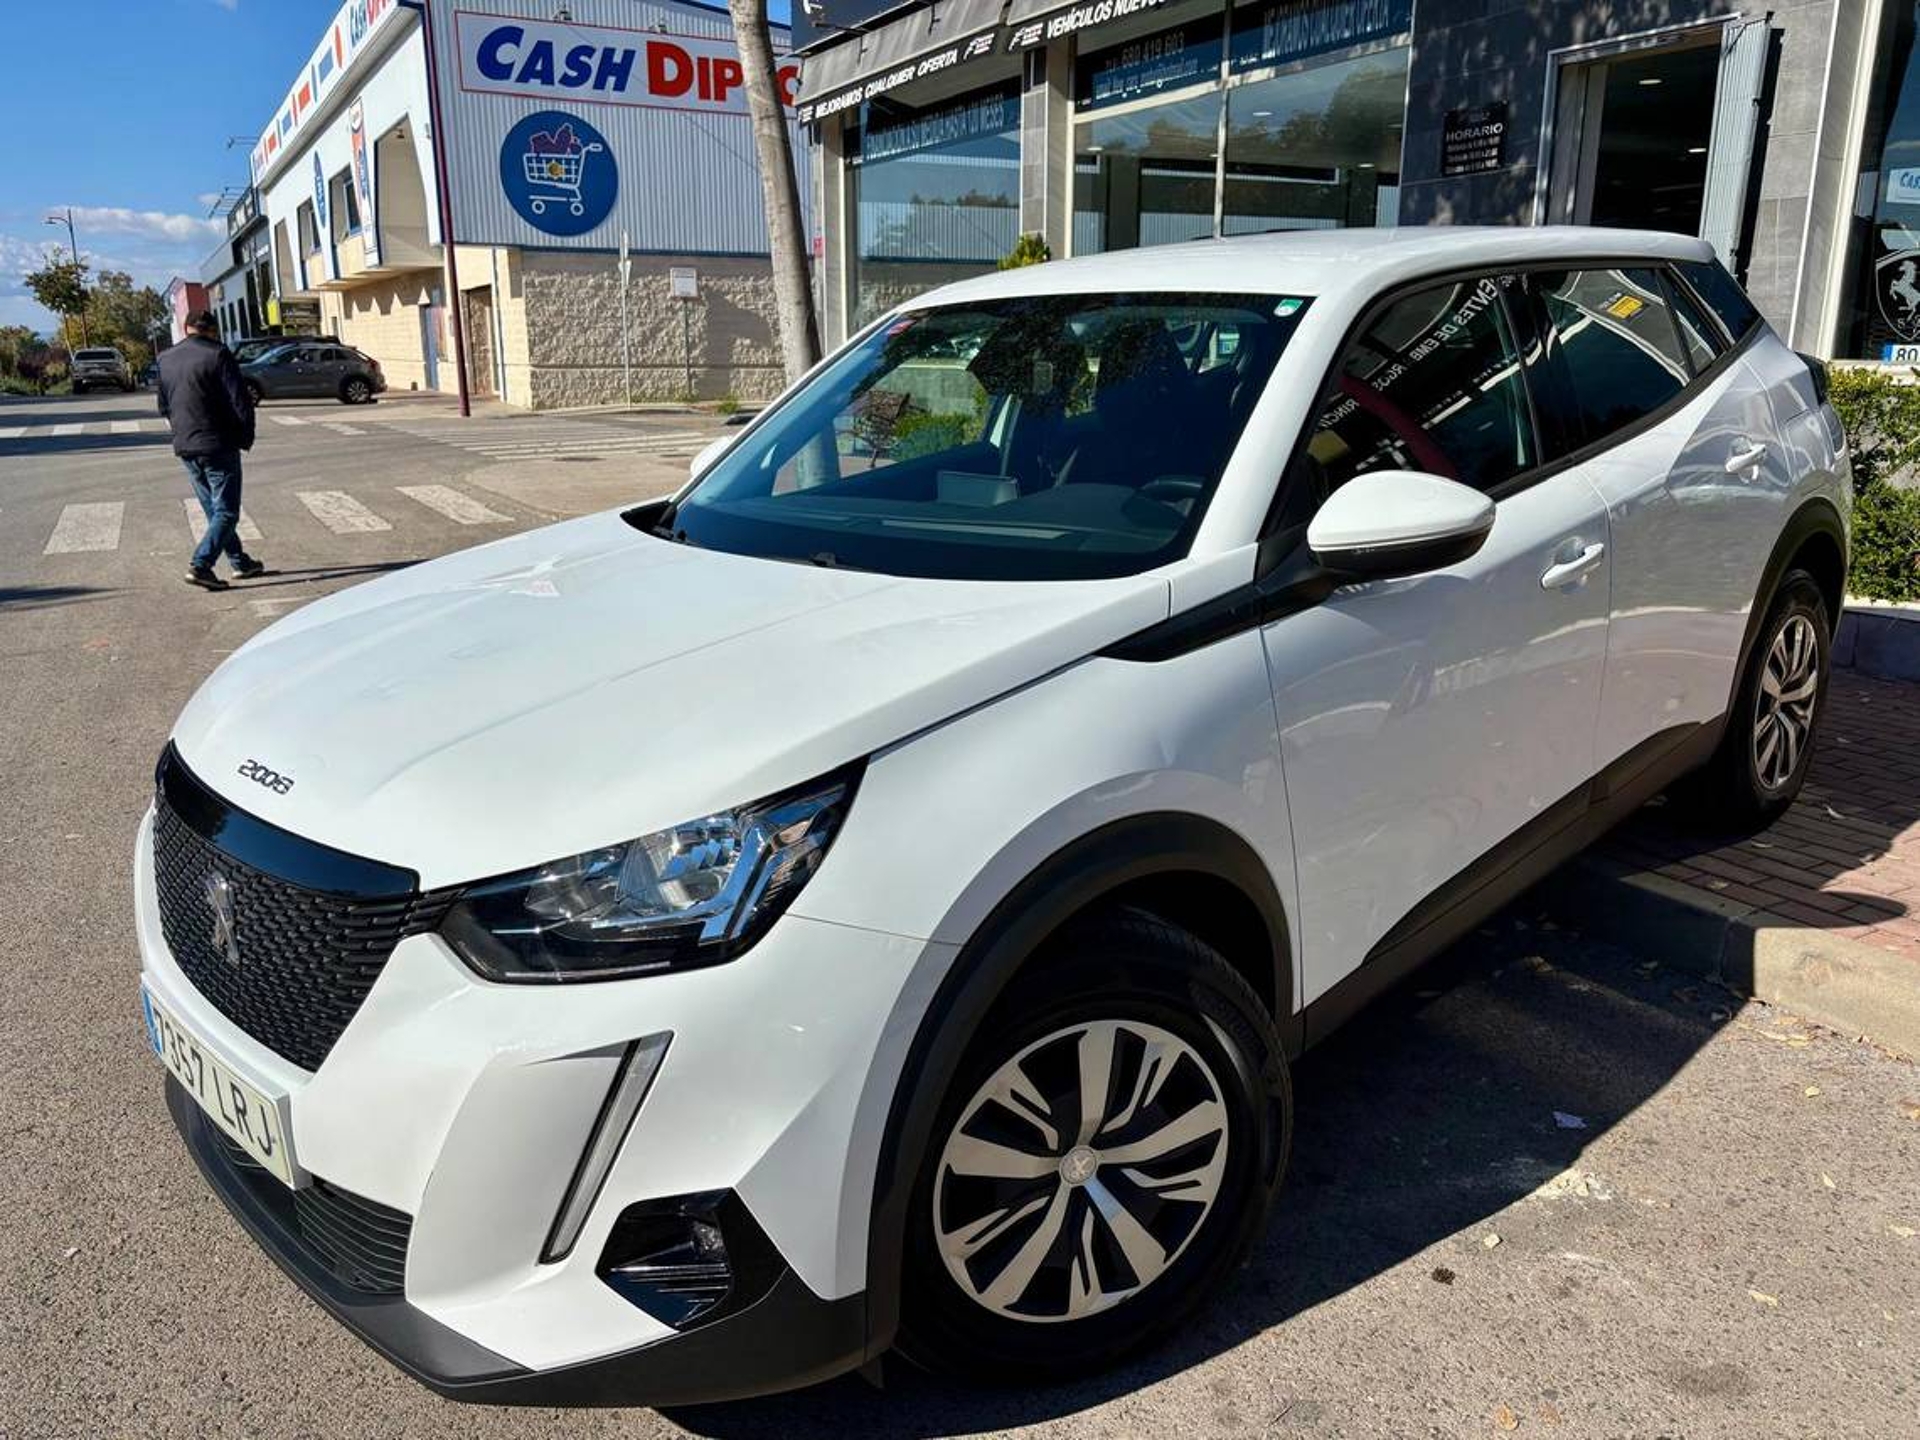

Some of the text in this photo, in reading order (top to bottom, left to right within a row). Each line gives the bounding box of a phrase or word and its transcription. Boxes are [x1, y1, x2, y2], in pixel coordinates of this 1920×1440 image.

[1047, 0, 1113, 38] VEHÍCULOS
[1112, 0, 1165, 17] NUE
[476, 26, 798, 107] CASH DIP
[815, 87, 863, 118] MEJORAMOS
[864, 66, 916, 99] CUALQUIER
[917, 49, 958, 77] OFERTA
[1446, 122, 1503, 142] HORARIO
[237, 759, 295, 795] 2008
[153, 1007, 273, 1157] 7357 LRJ
